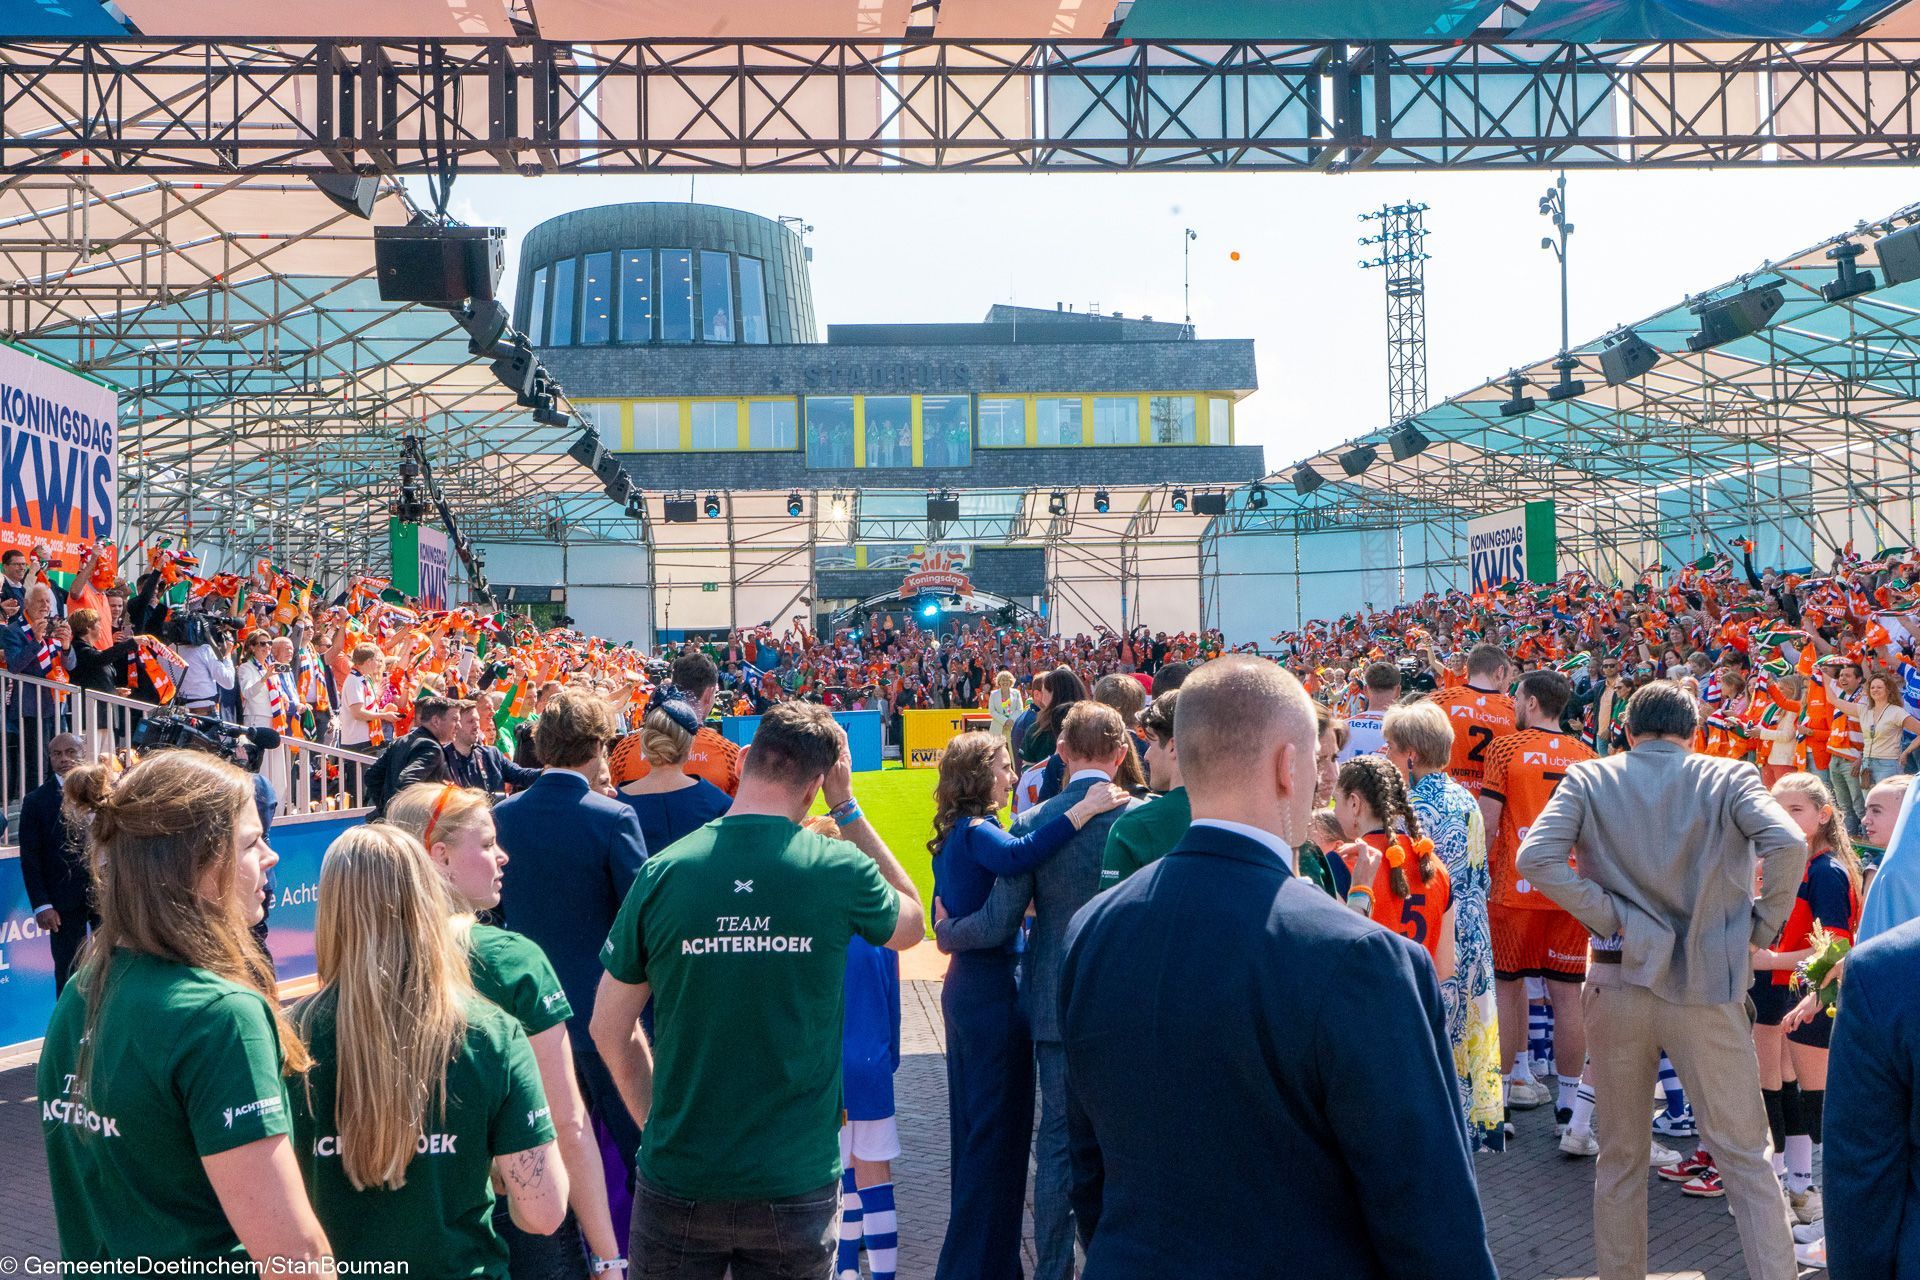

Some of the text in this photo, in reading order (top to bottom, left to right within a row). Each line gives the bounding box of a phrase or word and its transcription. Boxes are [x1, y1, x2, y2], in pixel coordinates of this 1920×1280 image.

[804, 363, 970, 387] STADHUIS
[1, 383, 112, 455] KONINGSDAG
[1, 425, 112, 540] KWIS
[1471, 525, 1523, 551] KONINGSDAG
[908, 573, 964, 586] Koningsdag
[1471, 543, 1524, 594] KWIS
[420, 561, 447, 610] KWIS
[1475, 711, 1511, 726] ubbink
[1468, 725, 1493, 762] 2
[716, 916, 771, 932] TEAM
[1401, 894, 1427, 944] 5
[681, 936, 813, 955] ACHTERHOEK
